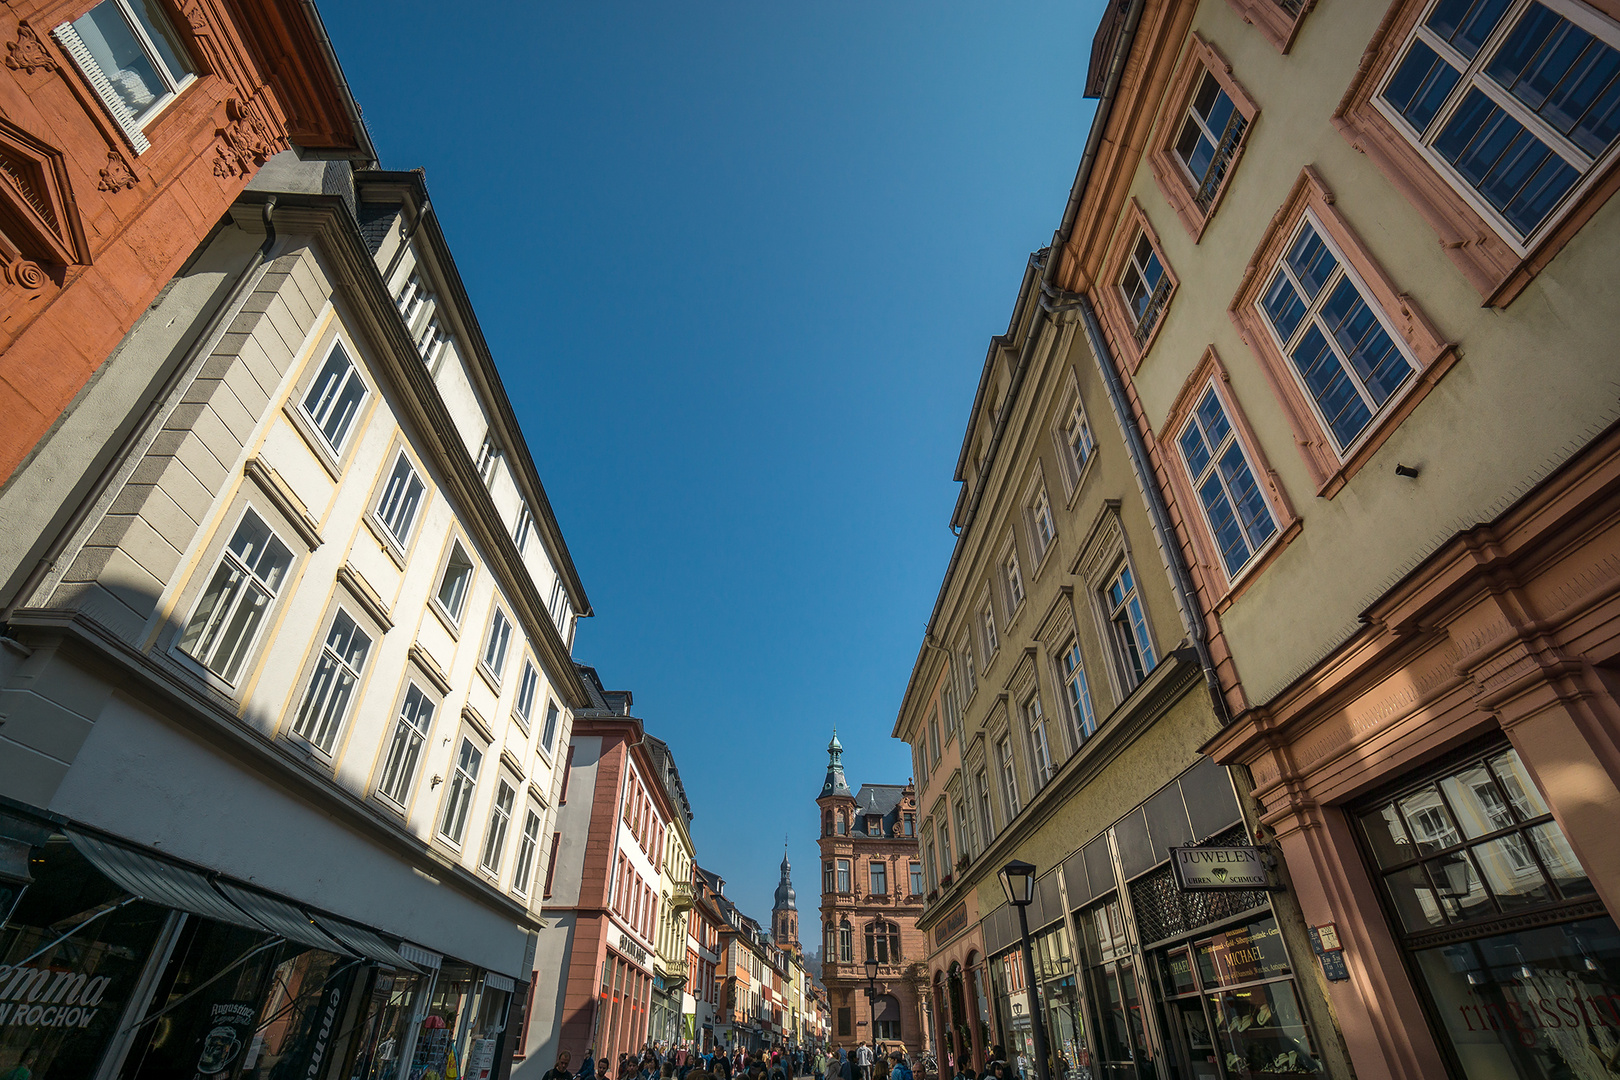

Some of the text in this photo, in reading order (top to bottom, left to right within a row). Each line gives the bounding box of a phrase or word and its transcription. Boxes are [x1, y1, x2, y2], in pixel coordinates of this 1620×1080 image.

[1183, 851, 1256, 863] JUWELEN
[1224, 946, 1265, 967] MICHAEL
[9, 1004, 99, 1028] ROCHOW
[210, 1003, 255, 1018] Augustiner
[306, 987, 341, 1080] emm
